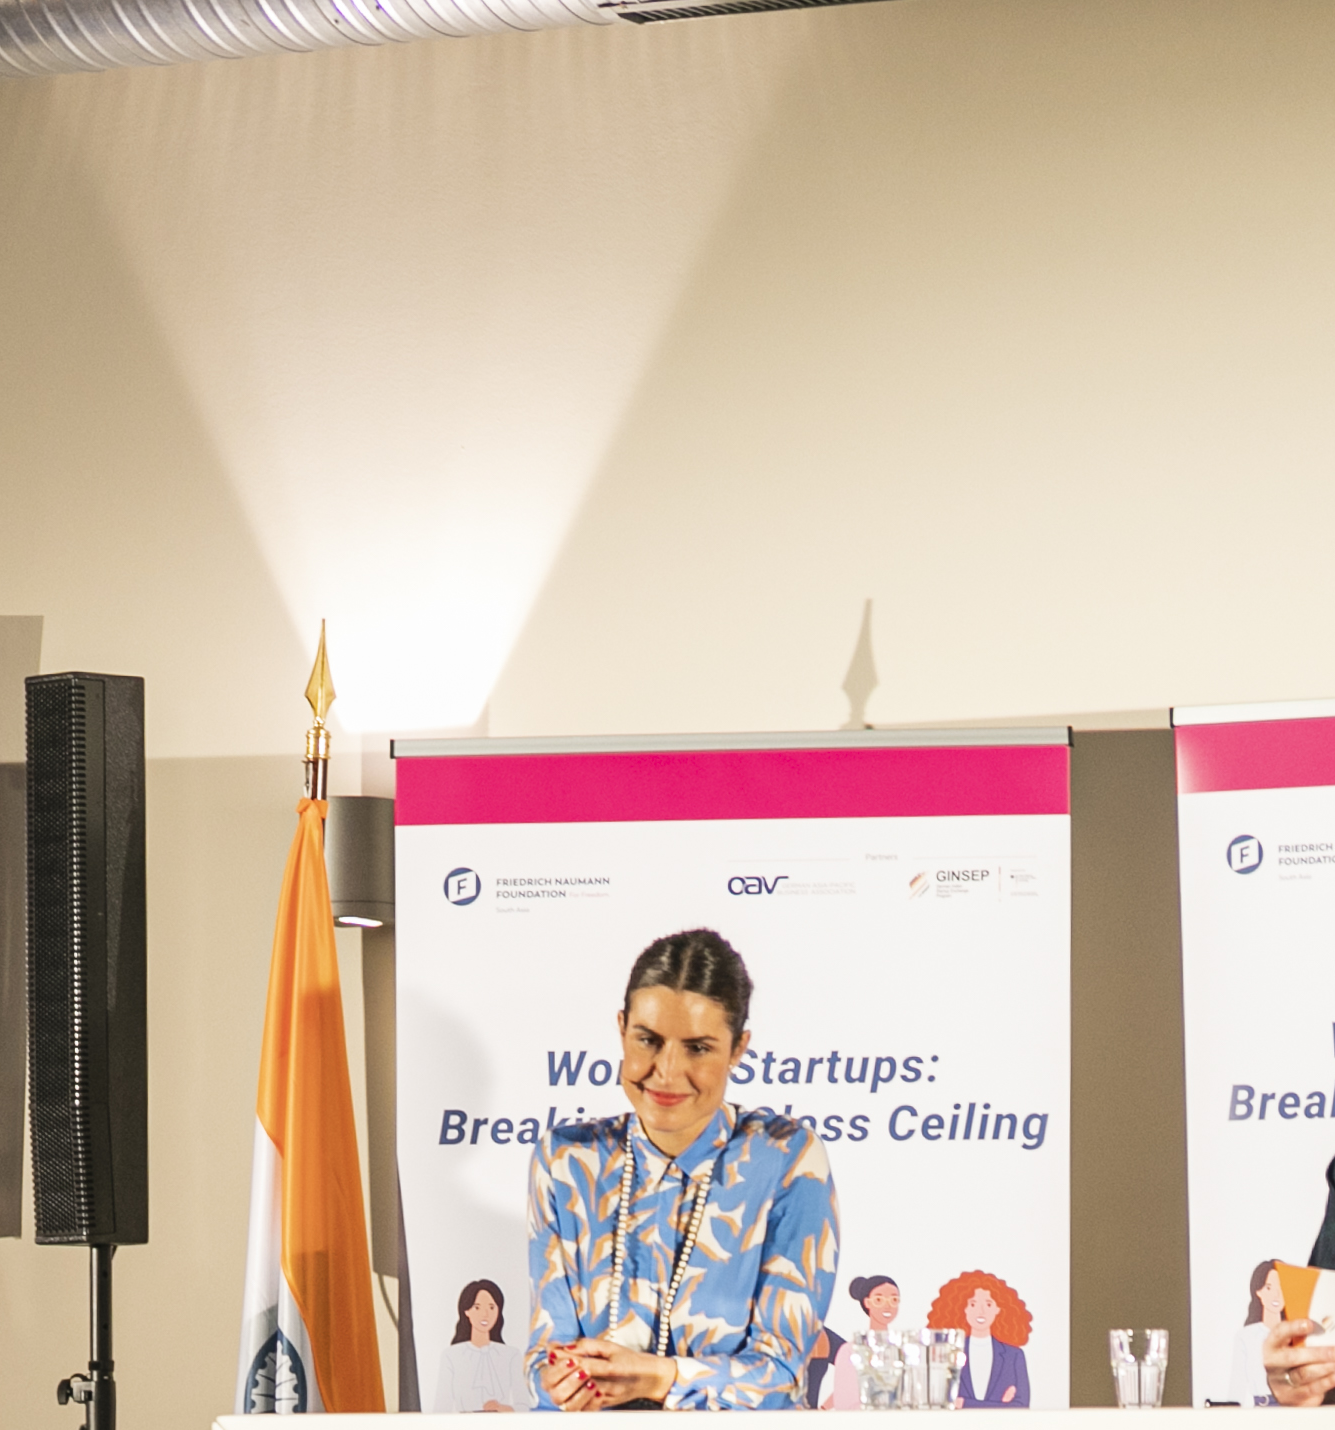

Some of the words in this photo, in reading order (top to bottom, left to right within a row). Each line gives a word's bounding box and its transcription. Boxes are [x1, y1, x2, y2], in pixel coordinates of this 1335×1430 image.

[1278, 843, 1333, 853] FRIEDRICH
[936, 870, 990, 882] GINSEP
[496, 878, 552, 887] FRIEDRICH
[555, 877, 610, 886] NAUMANN
[496, 890, 566, 899] FOUNDATION
[728, 1048, 939, 1093] Startups:
[888, 1102, 1049, 1150] Ceiling
